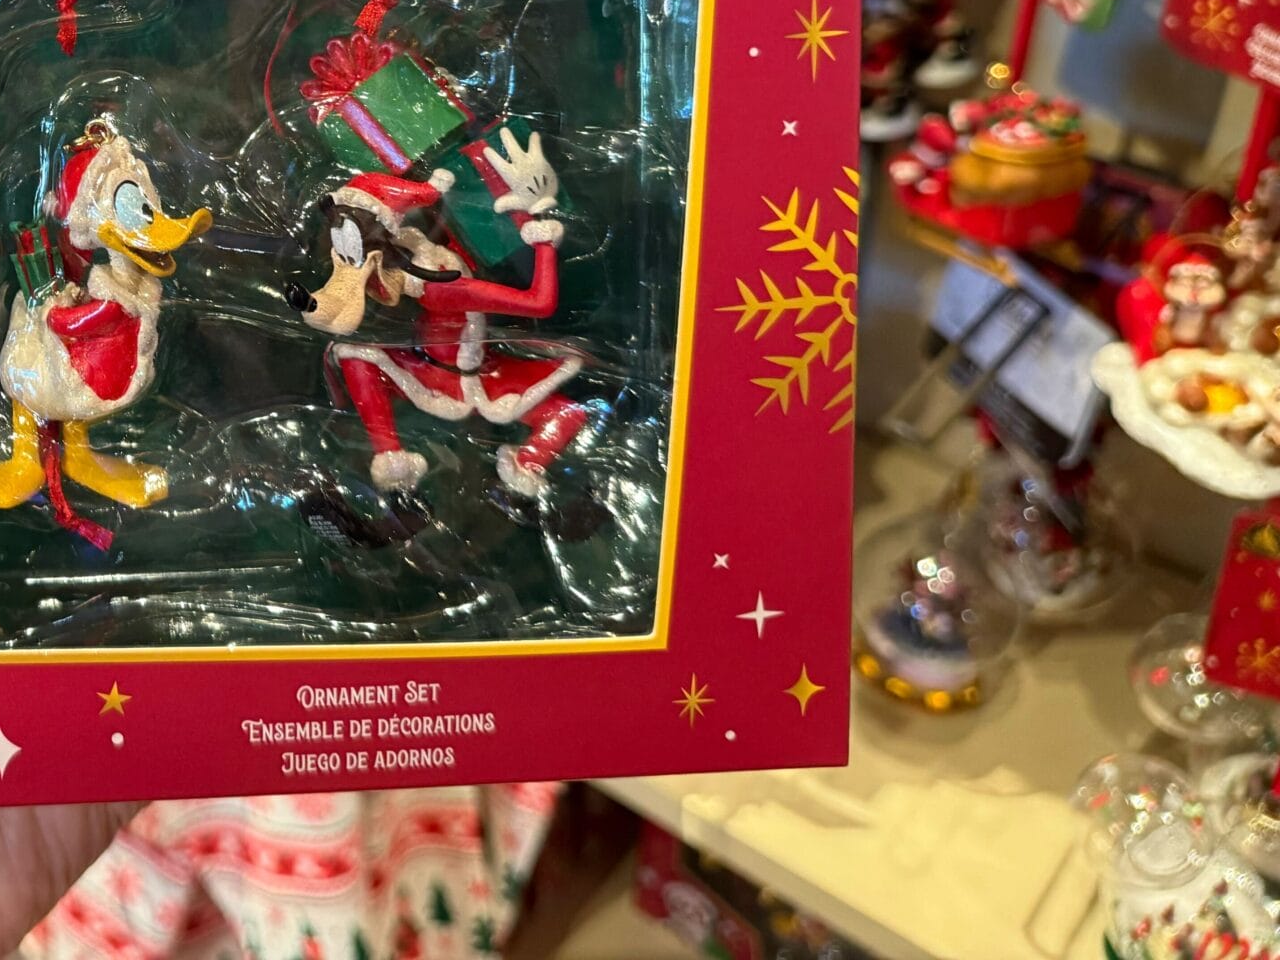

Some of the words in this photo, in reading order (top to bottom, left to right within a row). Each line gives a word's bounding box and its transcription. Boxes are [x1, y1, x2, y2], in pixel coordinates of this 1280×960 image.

[296, 684, 399, 709] ORNAMENT
[404, 681, 440, 703] SET
[242, 719, 344, 742] ENSEMBLE
[349, 719, 371, 738] DE
[377, 712, 496, 737] DÉCORATIONS
[282, 751, 340, 774] JUEGO
[346, 751, 369, 770] DE
[374, 746, 456, 769] ADORNOS
